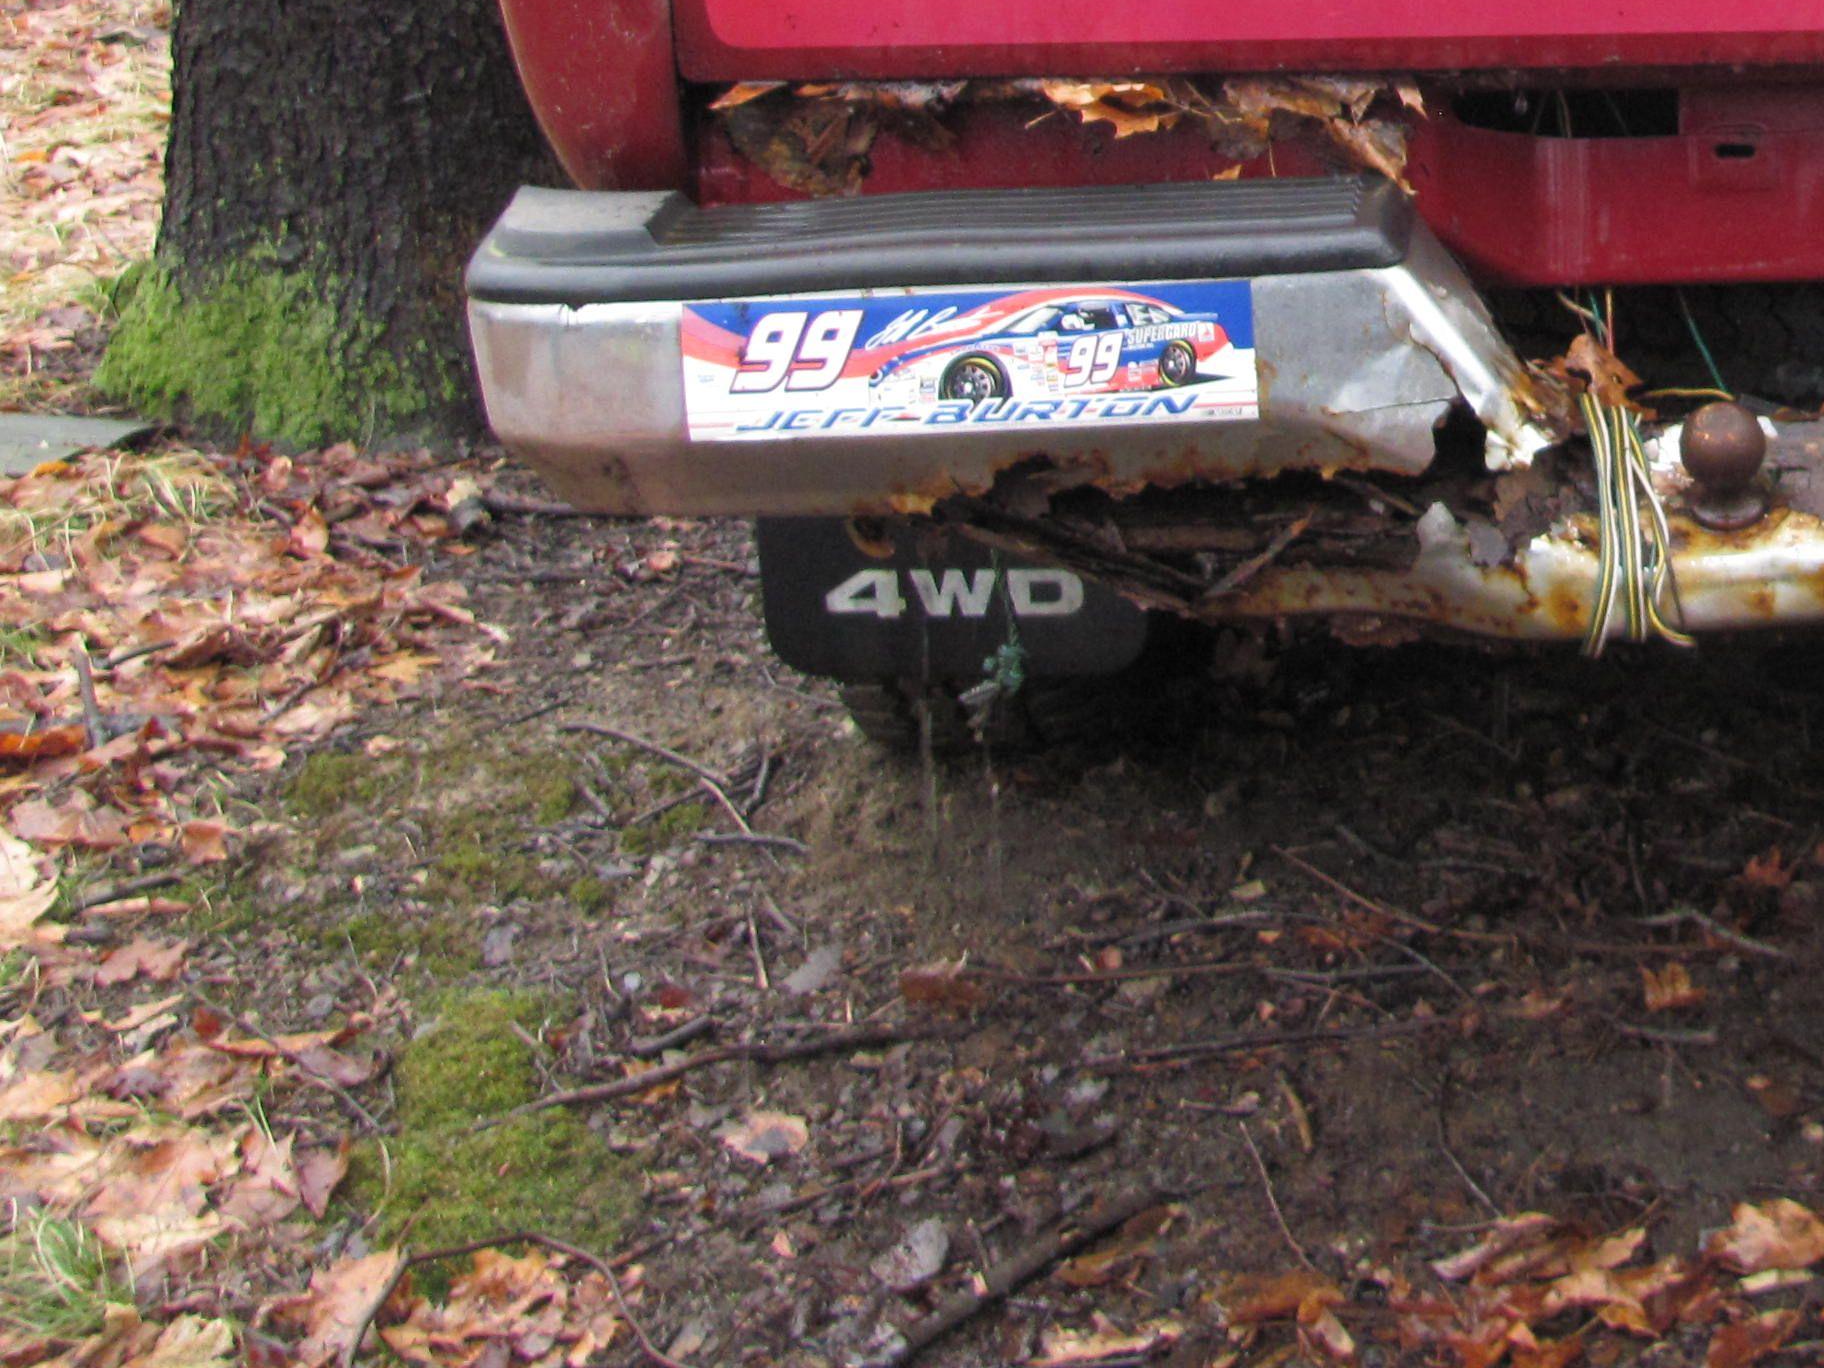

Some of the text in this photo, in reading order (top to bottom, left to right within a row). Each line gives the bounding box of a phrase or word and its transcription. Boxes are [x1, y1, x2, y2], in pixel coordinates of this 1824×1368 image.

[730, 310, 863, 393] 99
[1064, 332, 1124, 388] 99
[736, 393, 1199, 432] JEFF BURTON
[825, 568, 1085, 618] 4WD
